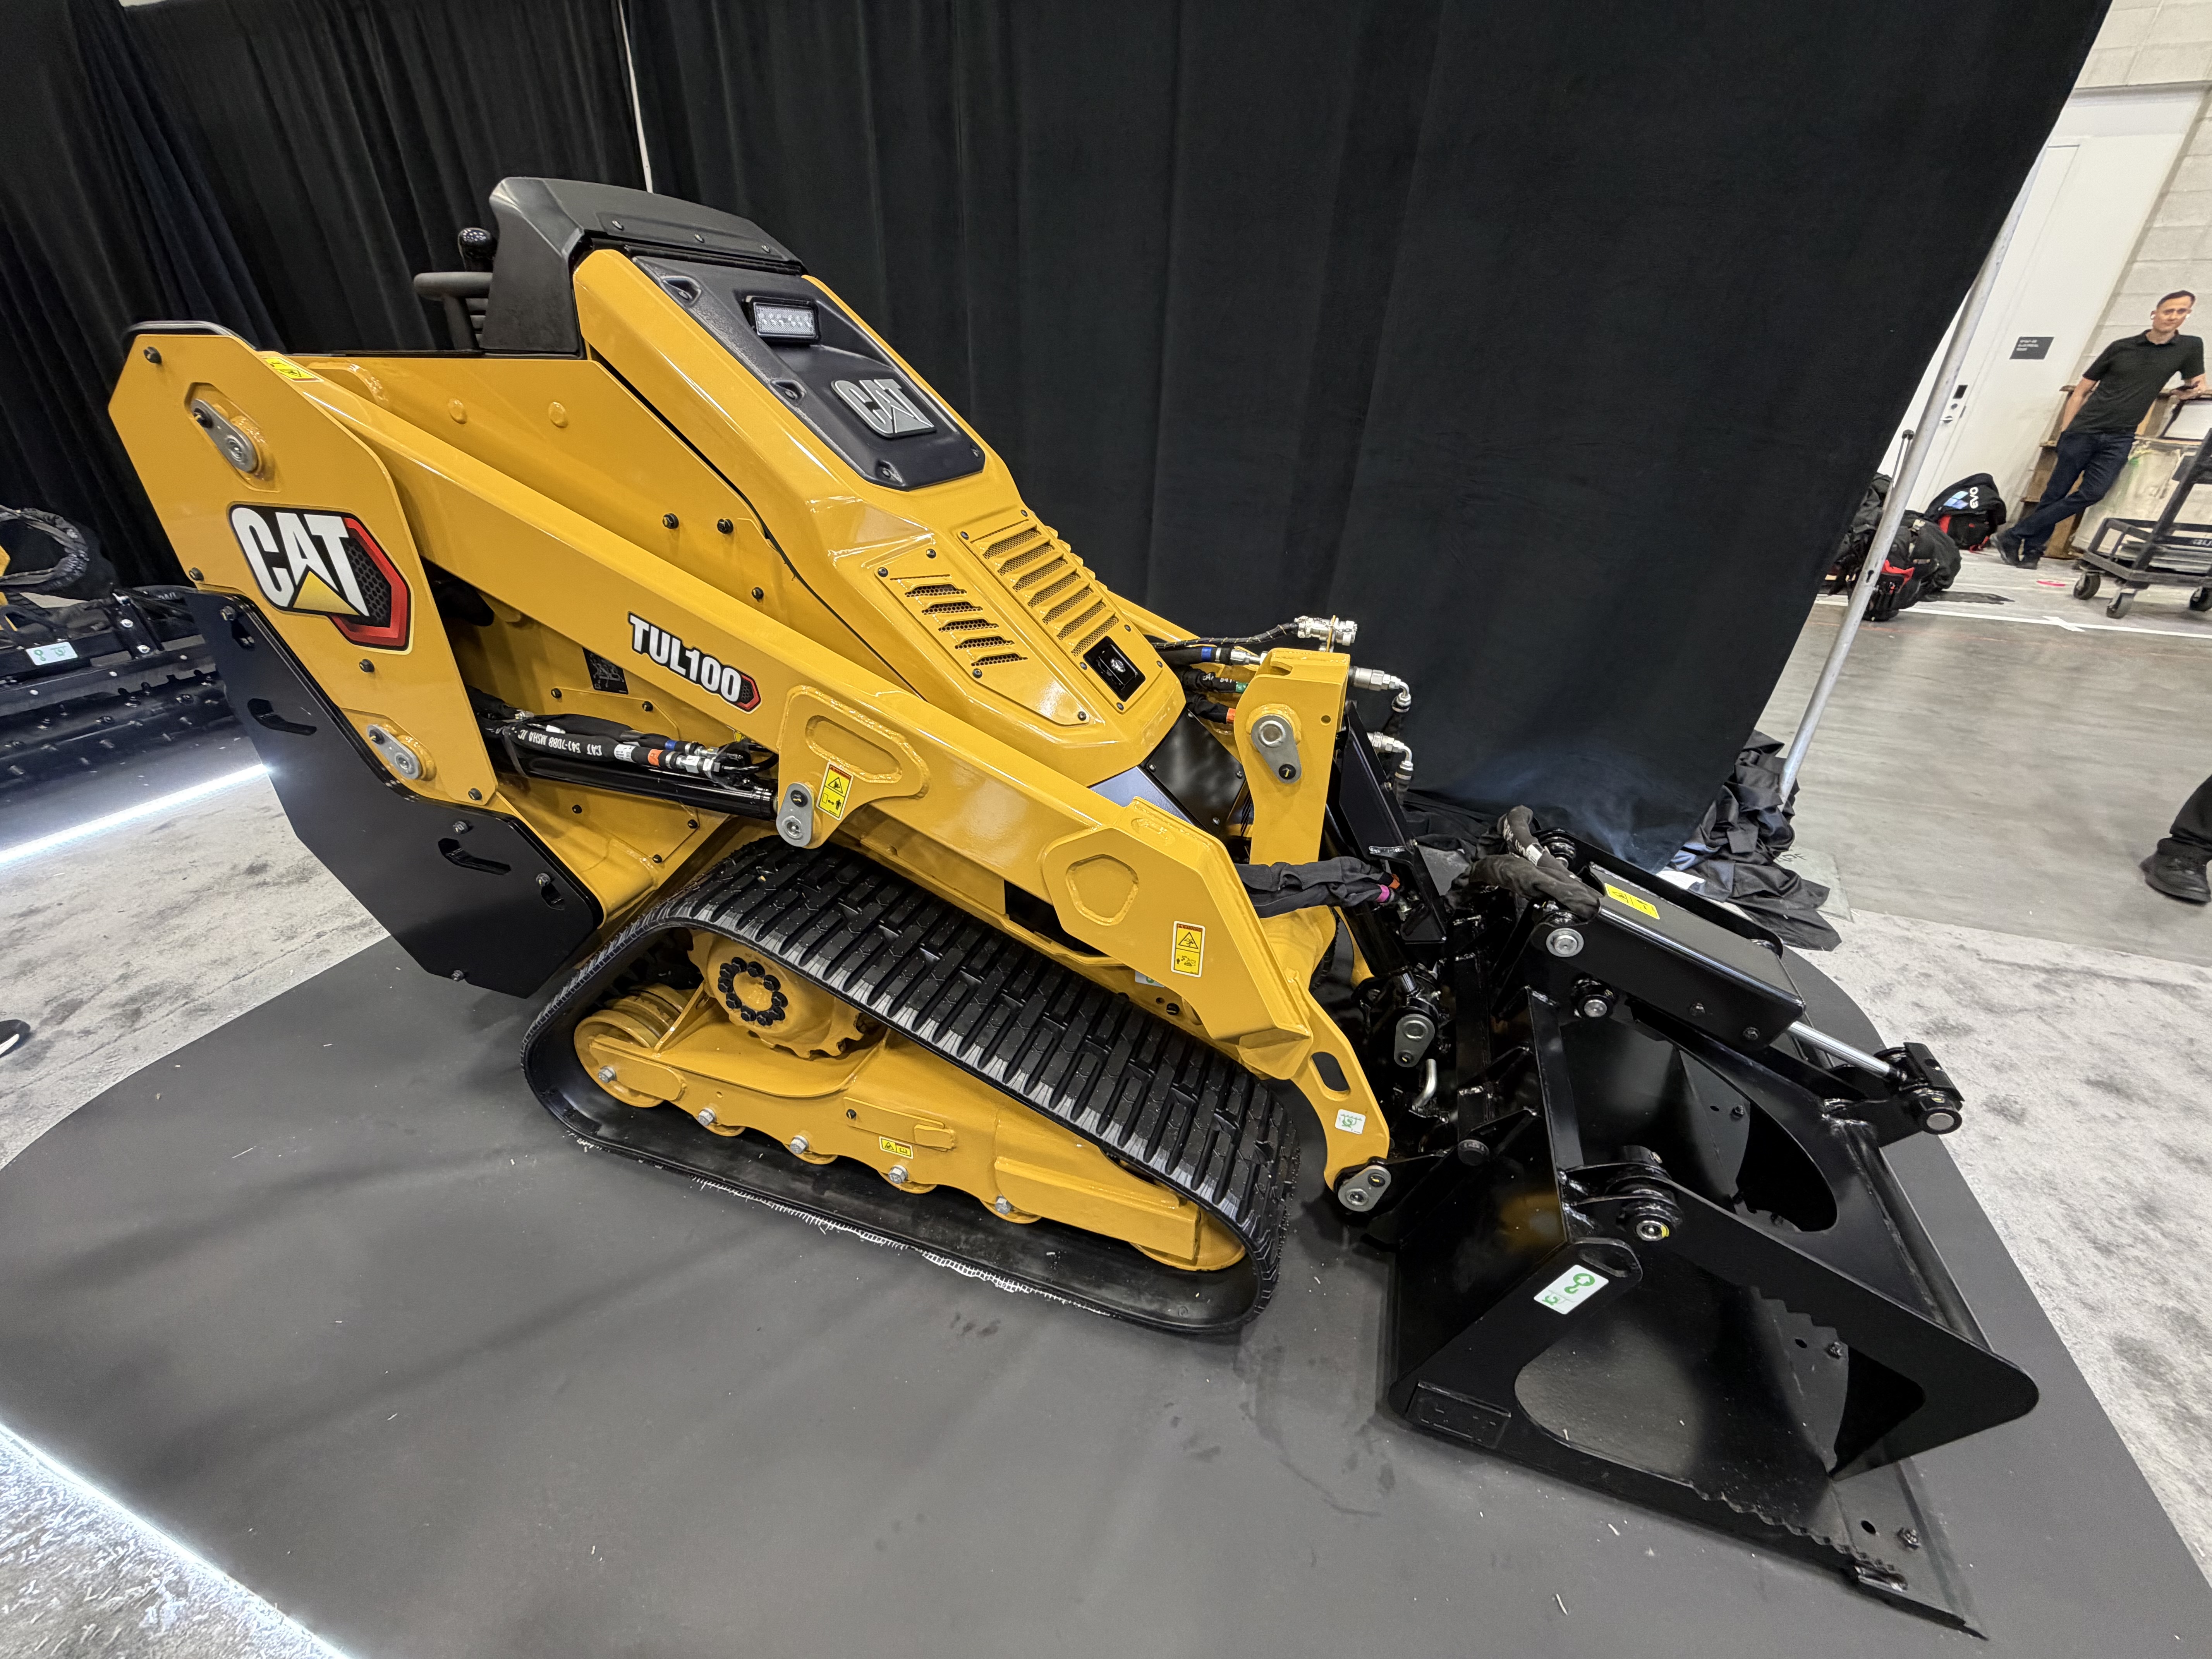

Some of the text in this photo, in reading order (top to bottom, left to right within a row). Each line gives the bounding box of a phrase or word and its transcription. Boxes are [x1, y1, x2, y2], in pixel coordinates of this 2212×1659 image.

[835, 379, 934, 434] CAT
[1970, 487, 1978, 508] EVO
[232, 507, 370, 617] CAT
[630, 615, 741, 702] TUL100
[528, 731, 548, 745] MSHA
[548, 737, 582, 753] 541-7088
[587, 744, 602, 756] CAT
